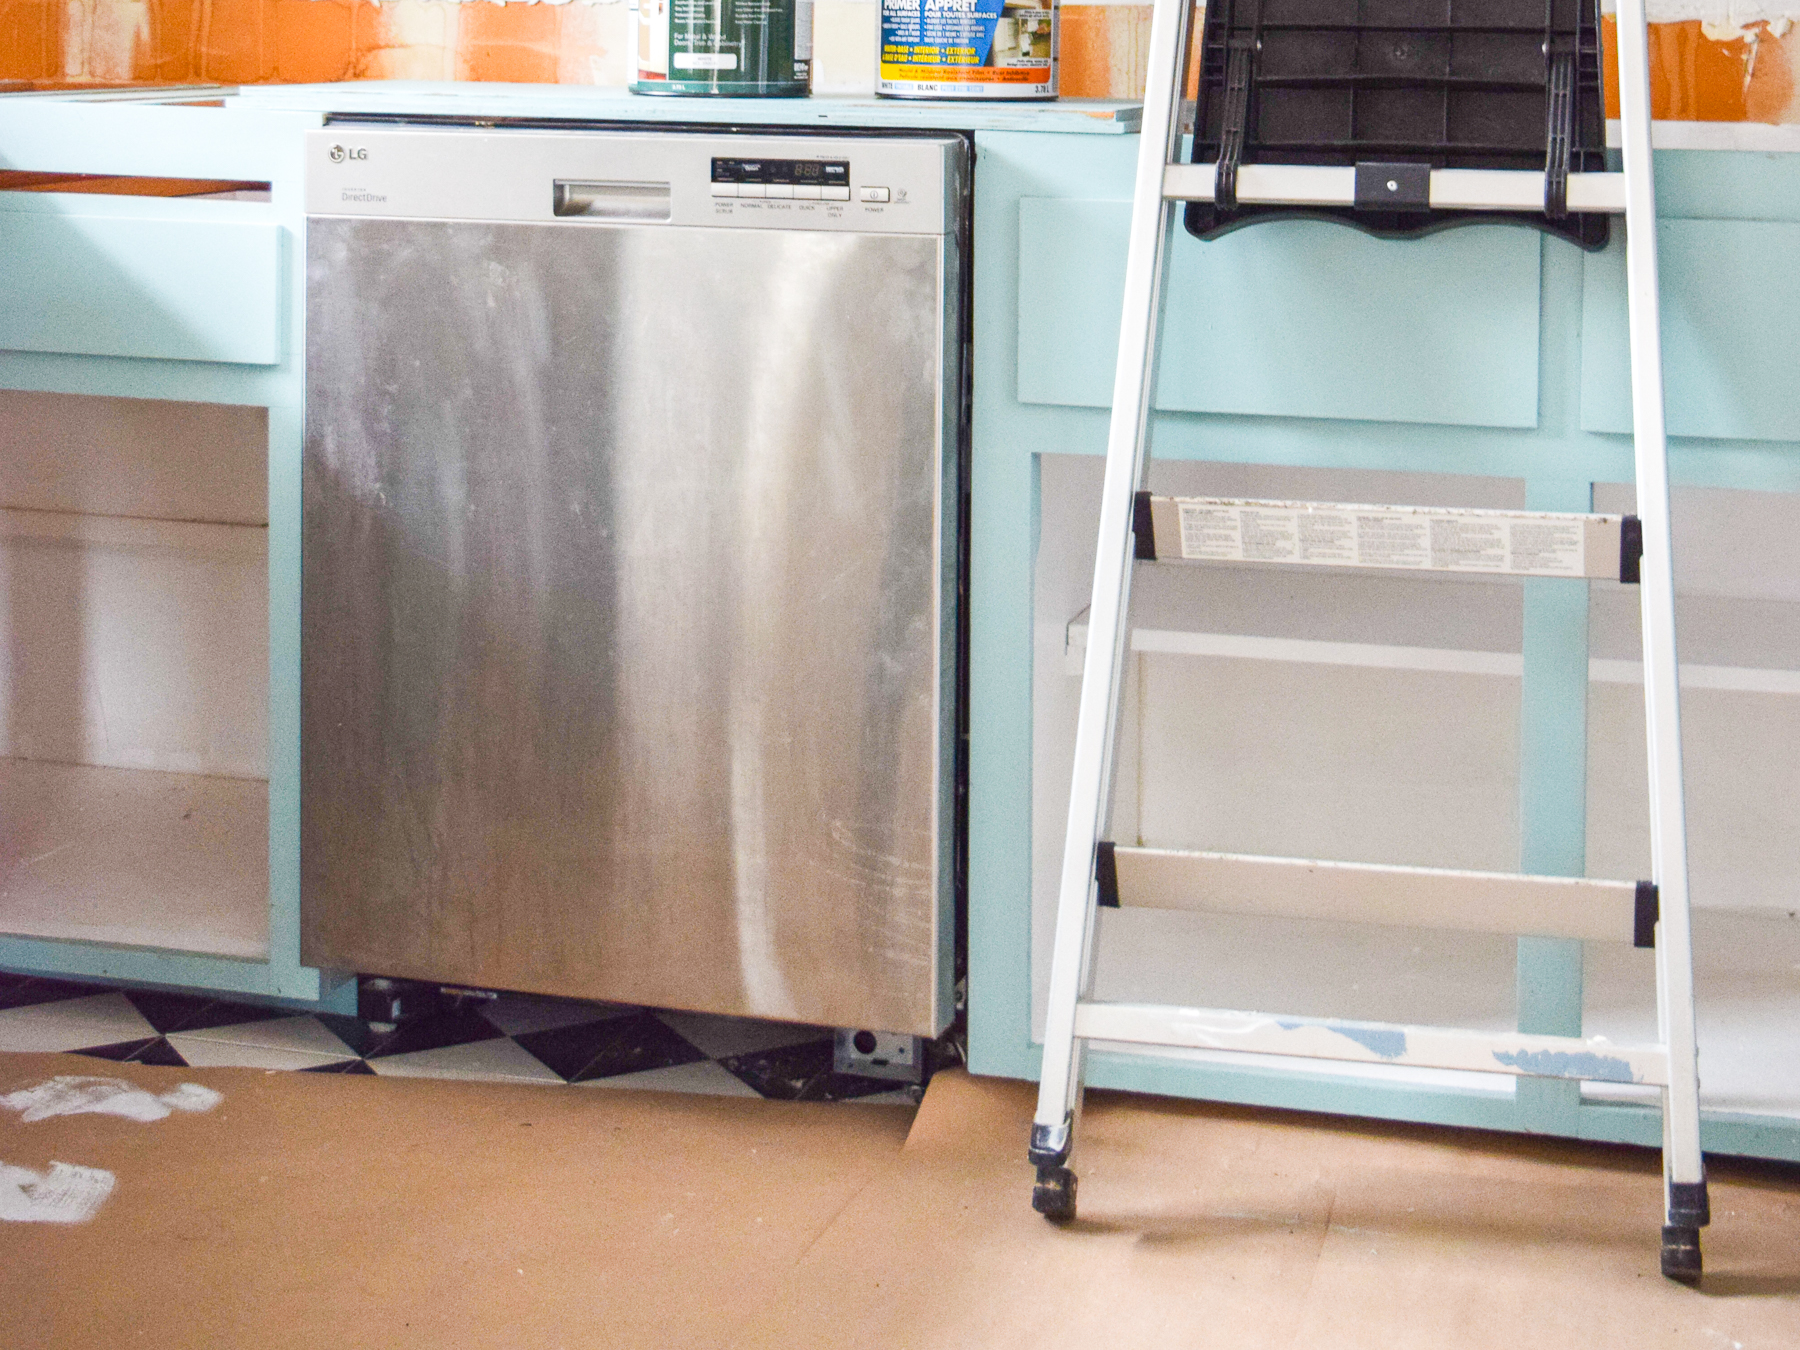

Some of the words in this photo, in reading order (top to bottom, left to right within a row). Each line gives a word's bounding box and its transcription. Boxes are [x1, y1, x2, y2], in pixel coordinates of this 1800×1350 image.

[945, 46, 976, 55] EXTERIOR
[917, 84, 938, 92] BLANC
[349, 148, 368, 160] LG
